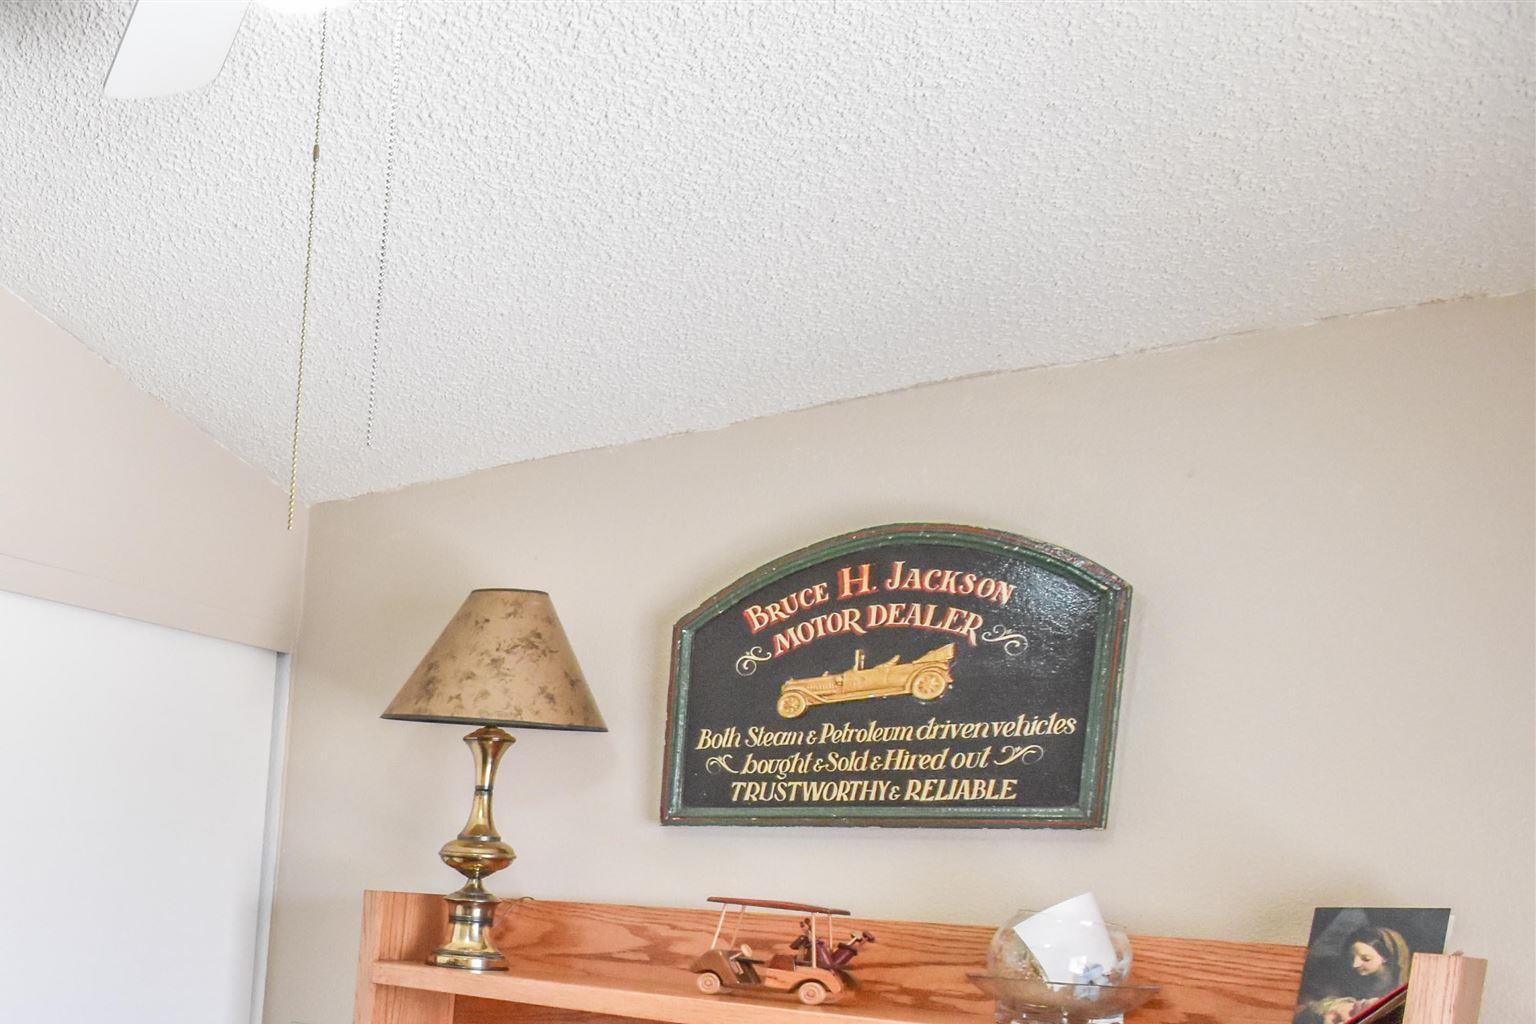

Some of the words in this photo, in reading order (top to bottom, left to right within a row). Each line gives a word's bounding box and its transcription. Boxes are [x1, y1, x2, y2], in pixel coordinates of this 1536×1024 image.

[744, 582, 830, 634] BRUCE
[838, 563, 880, 599] H.
[885, 560, 1017, 605] JACKSON
[773, 607, 868, 658] MOTOR
[867, 602, 984, 647] DEALER
[695, 726, 742, 750] Both
[745, 726, 804, 748] Steam
[806, 730, 817, 745] &
[818, 720, 914, 745] Petroleum
[916, 717, 989, 740] driven
[990, 712, 1078, 737] vehicles
[740, 751, 813, 779] bought
[825, 750, 870, 772] Sold
[882, 748, 950, 771] Hired
[951, 745, 993, 769] out
[731, 780, 892, 802] TRUSTWORTHY
[904, 779, 1018, 802] RELIABLE
